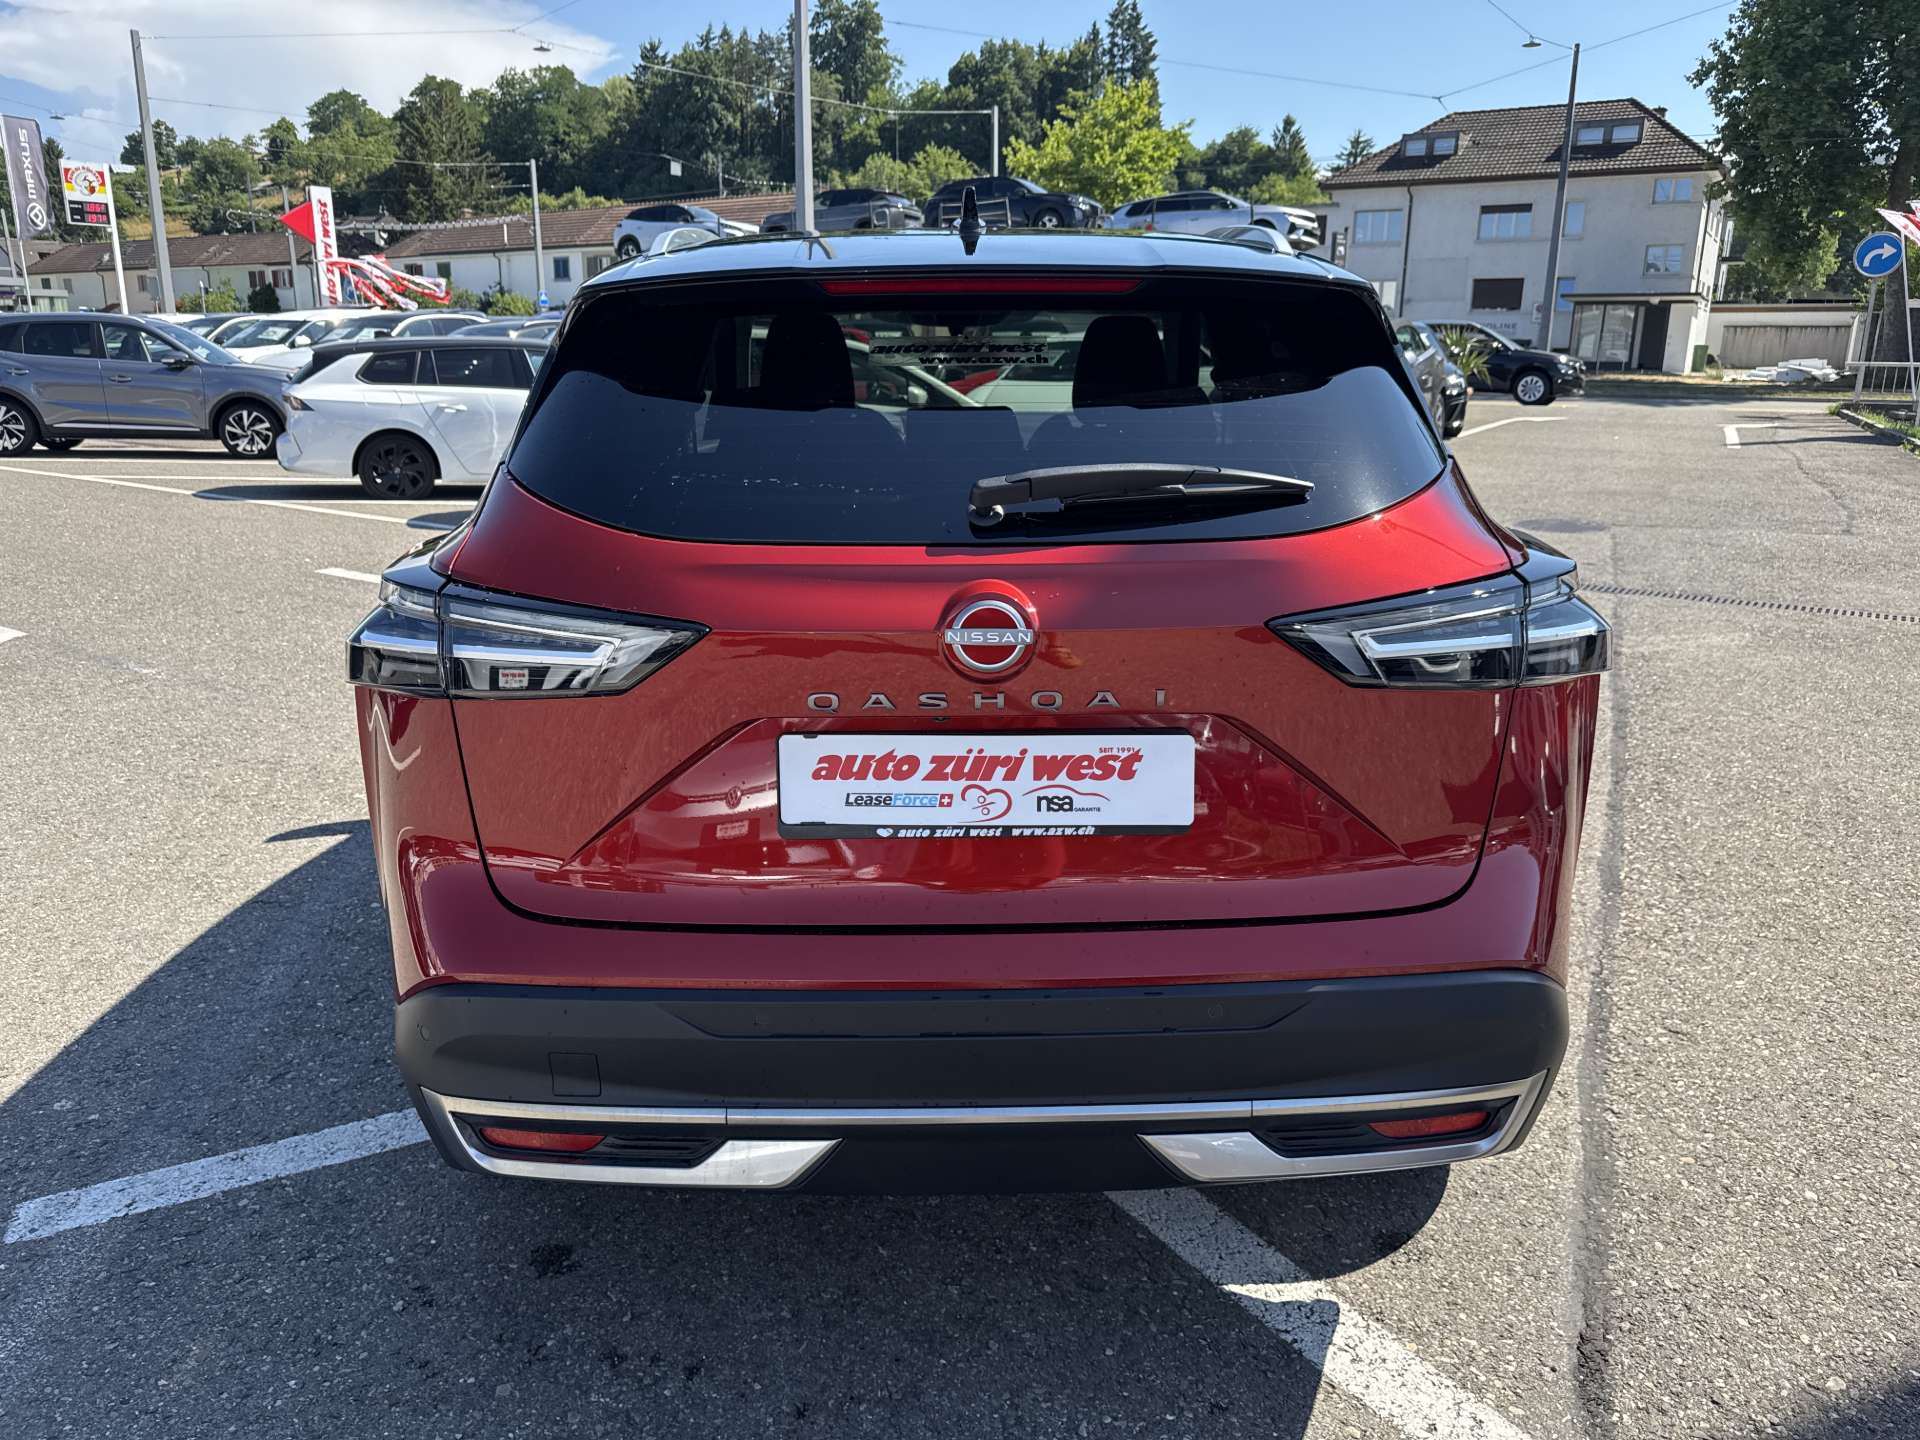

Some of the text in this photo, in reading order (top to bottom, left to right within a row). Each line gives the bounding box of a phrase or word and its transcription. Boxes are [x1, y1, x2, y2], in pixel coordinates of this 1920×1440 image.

[19, 127, 37, 199] MAXUS
[919, 354, 1049, 364] www.azw.ch
[947, 631, 1031, 643] NISSAN
[807, 689, 1167, 713] QASHQAI
[811, 747, 1144, 782] auto züri west
[845, 792, 939, 807] LeaseForce
[1036, 795, 1073, 812] nsa
[897, 825, 1096, 838] auto züri west www.azw.ch
